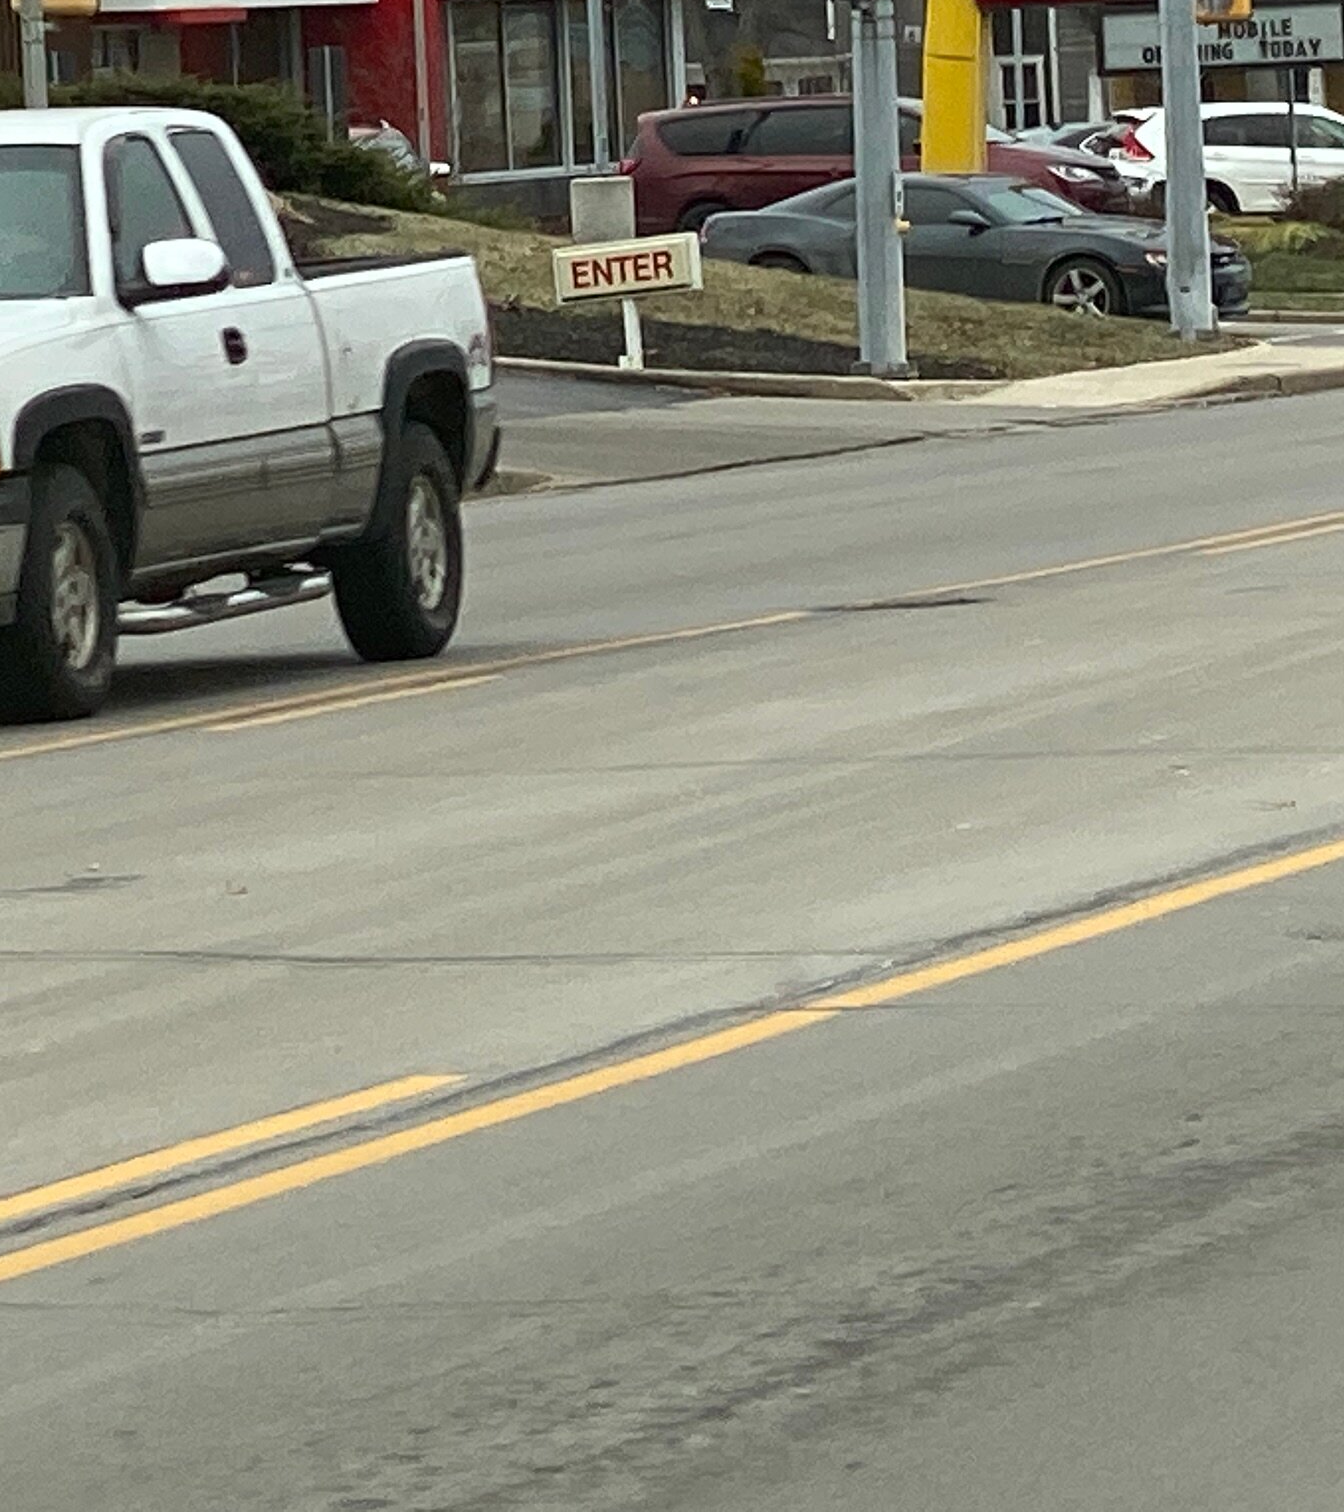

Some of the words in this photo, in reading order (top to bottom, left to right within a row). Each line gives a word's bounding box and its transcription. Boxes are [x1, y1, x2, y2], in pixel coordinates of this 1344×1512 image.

[1141, 41, 1234, 65] OING
[1258, 37, 1323, 59] TODAY
[570, 250, 675, 289] ENTER
